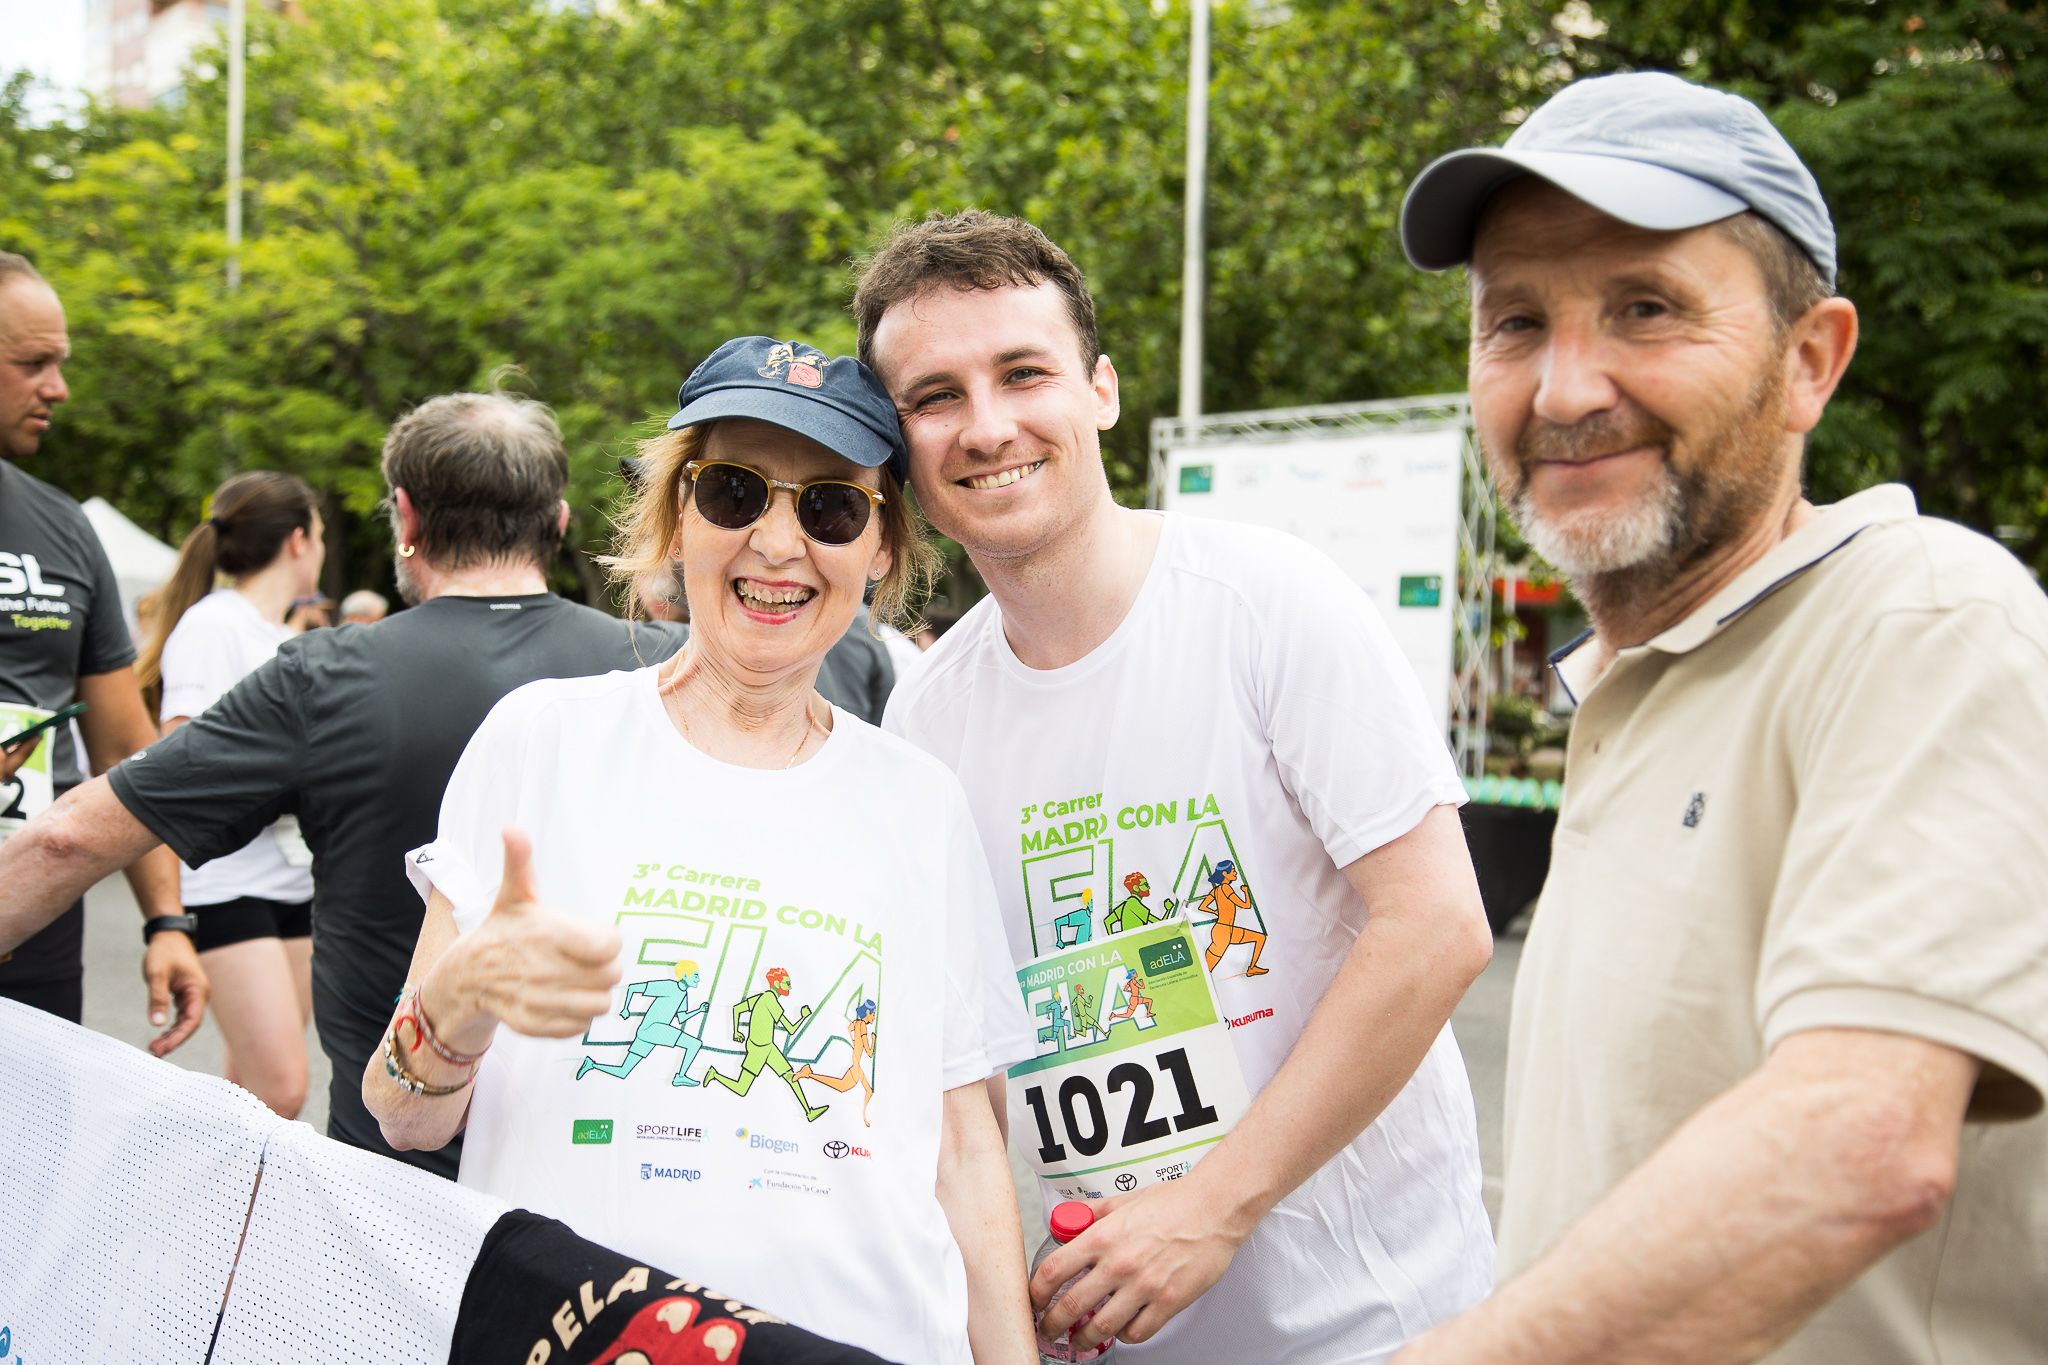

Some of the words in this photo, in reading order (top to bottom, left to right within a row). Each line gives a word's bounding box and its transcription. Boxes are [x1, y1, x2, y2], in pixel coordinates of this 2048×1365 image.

[11, 614, 72, 631] Together
[1043, 793, 1103, 819] Carrer
[1116, 800, 1177, 830] CON
[1187, 793, 1220, 821] LA
[667, 864, 760, 892] Carrera
[623, 886, 767, 920] MADRID
[776, 905, 847, 936] CON
[854, 923, 882, 956] LA
[1027, 964, 1065, 988] MADRID
[1068, 955, 1096, 976] CON
[1102, 949, 1122, 966] LA
[1150, 951, 1186, 970] adELA
[1025, 1047, 1219, 1164] 1021
[577, 1130, 608, 1140] adELA
[750, 1134, 799, 1154] Biogen
[654, 1167, 701, 1182] MADRID
[1156, 1163, 1184, 1178] SPORT
[766, 1180, 802, 1191] Fundación
